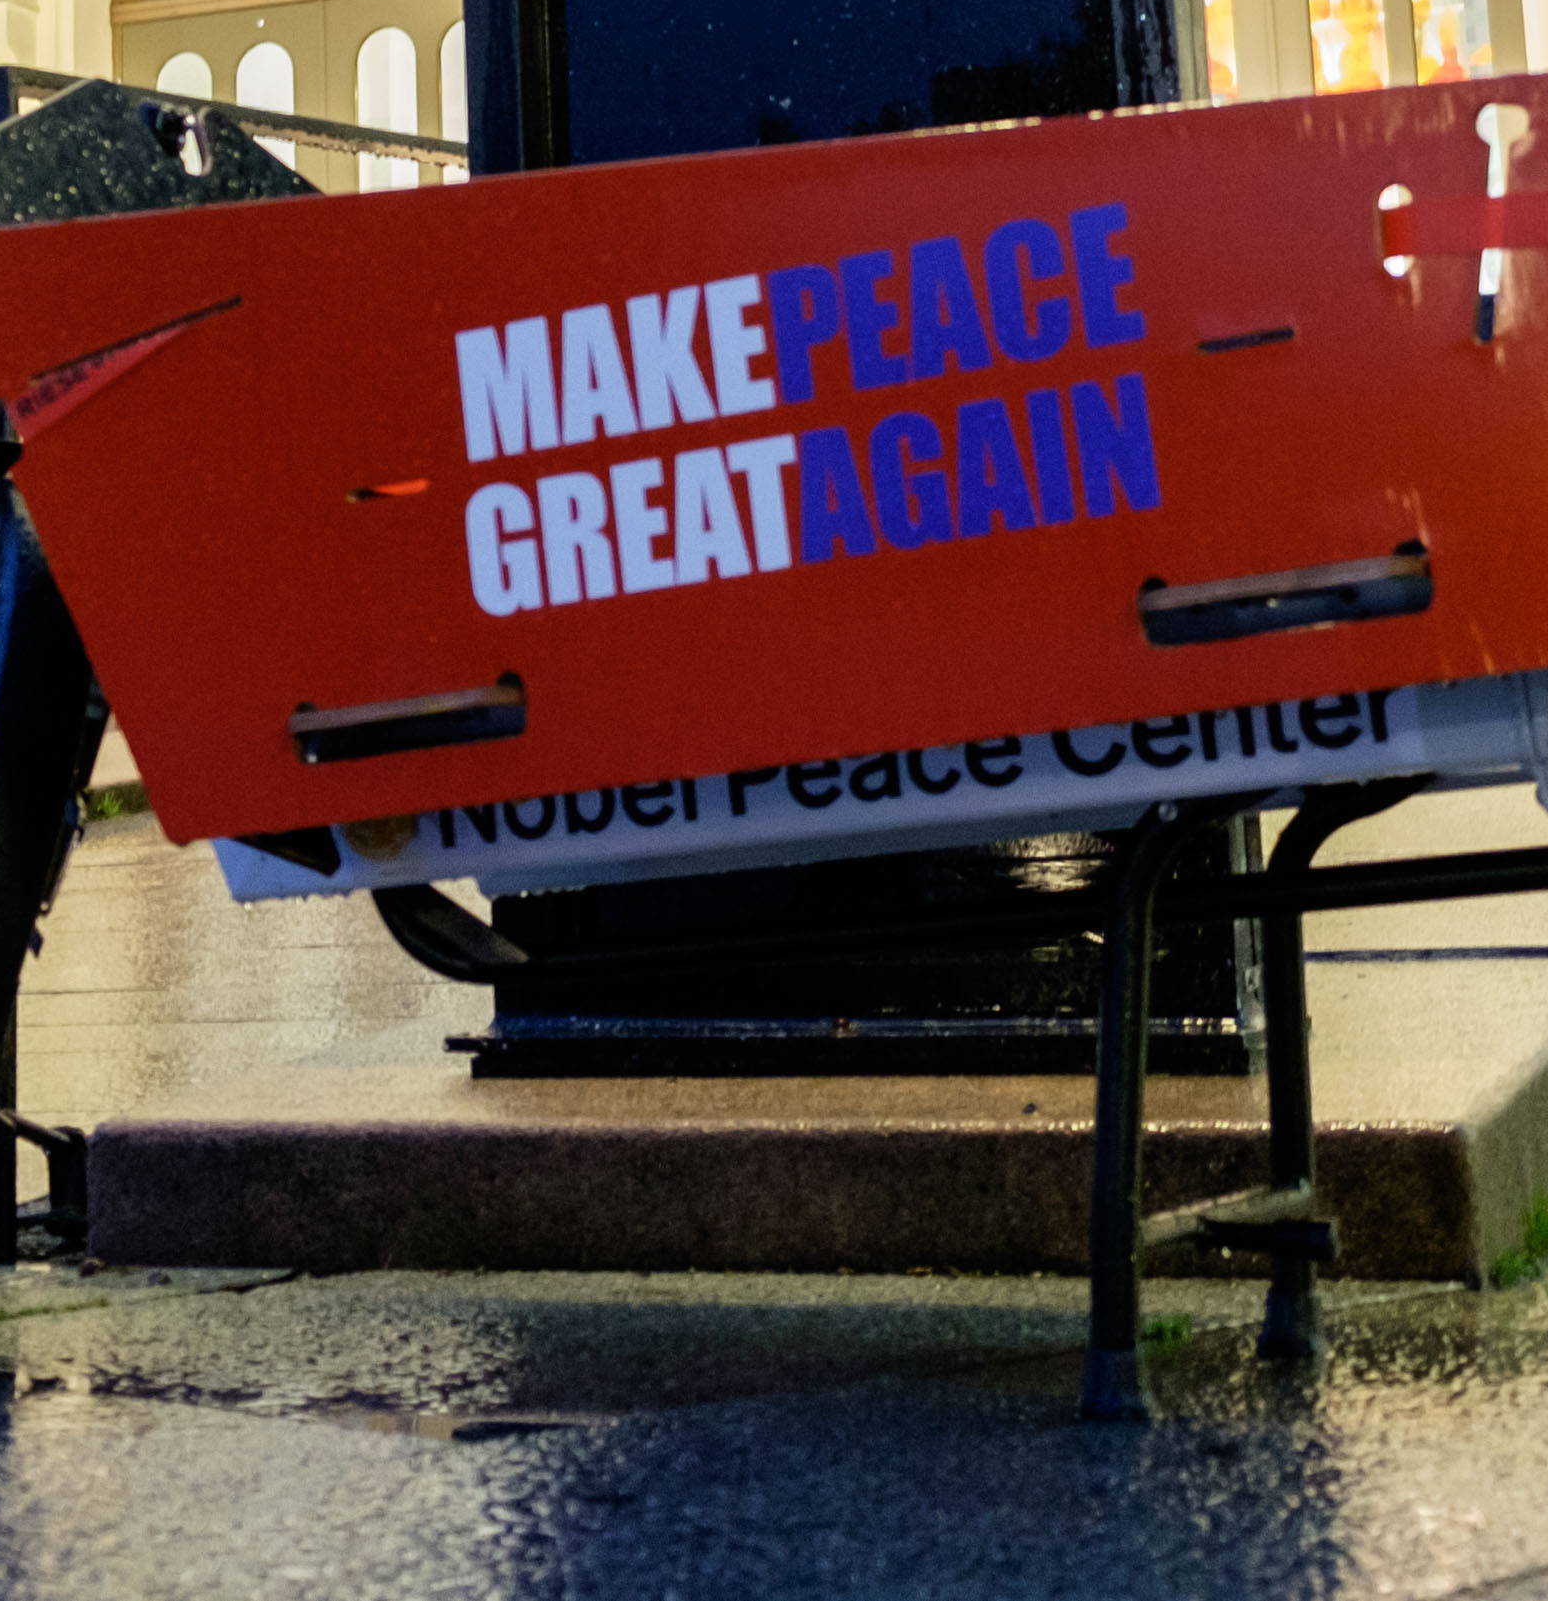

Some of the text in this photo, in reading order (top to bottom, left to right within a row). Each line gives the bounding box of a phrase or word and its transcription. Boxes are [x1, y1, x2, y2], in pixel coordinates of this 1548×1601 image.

[455, 202, 1146, 462] MAKE PEACE
[465, 373, 1161, 617] GREAT AGAIN
